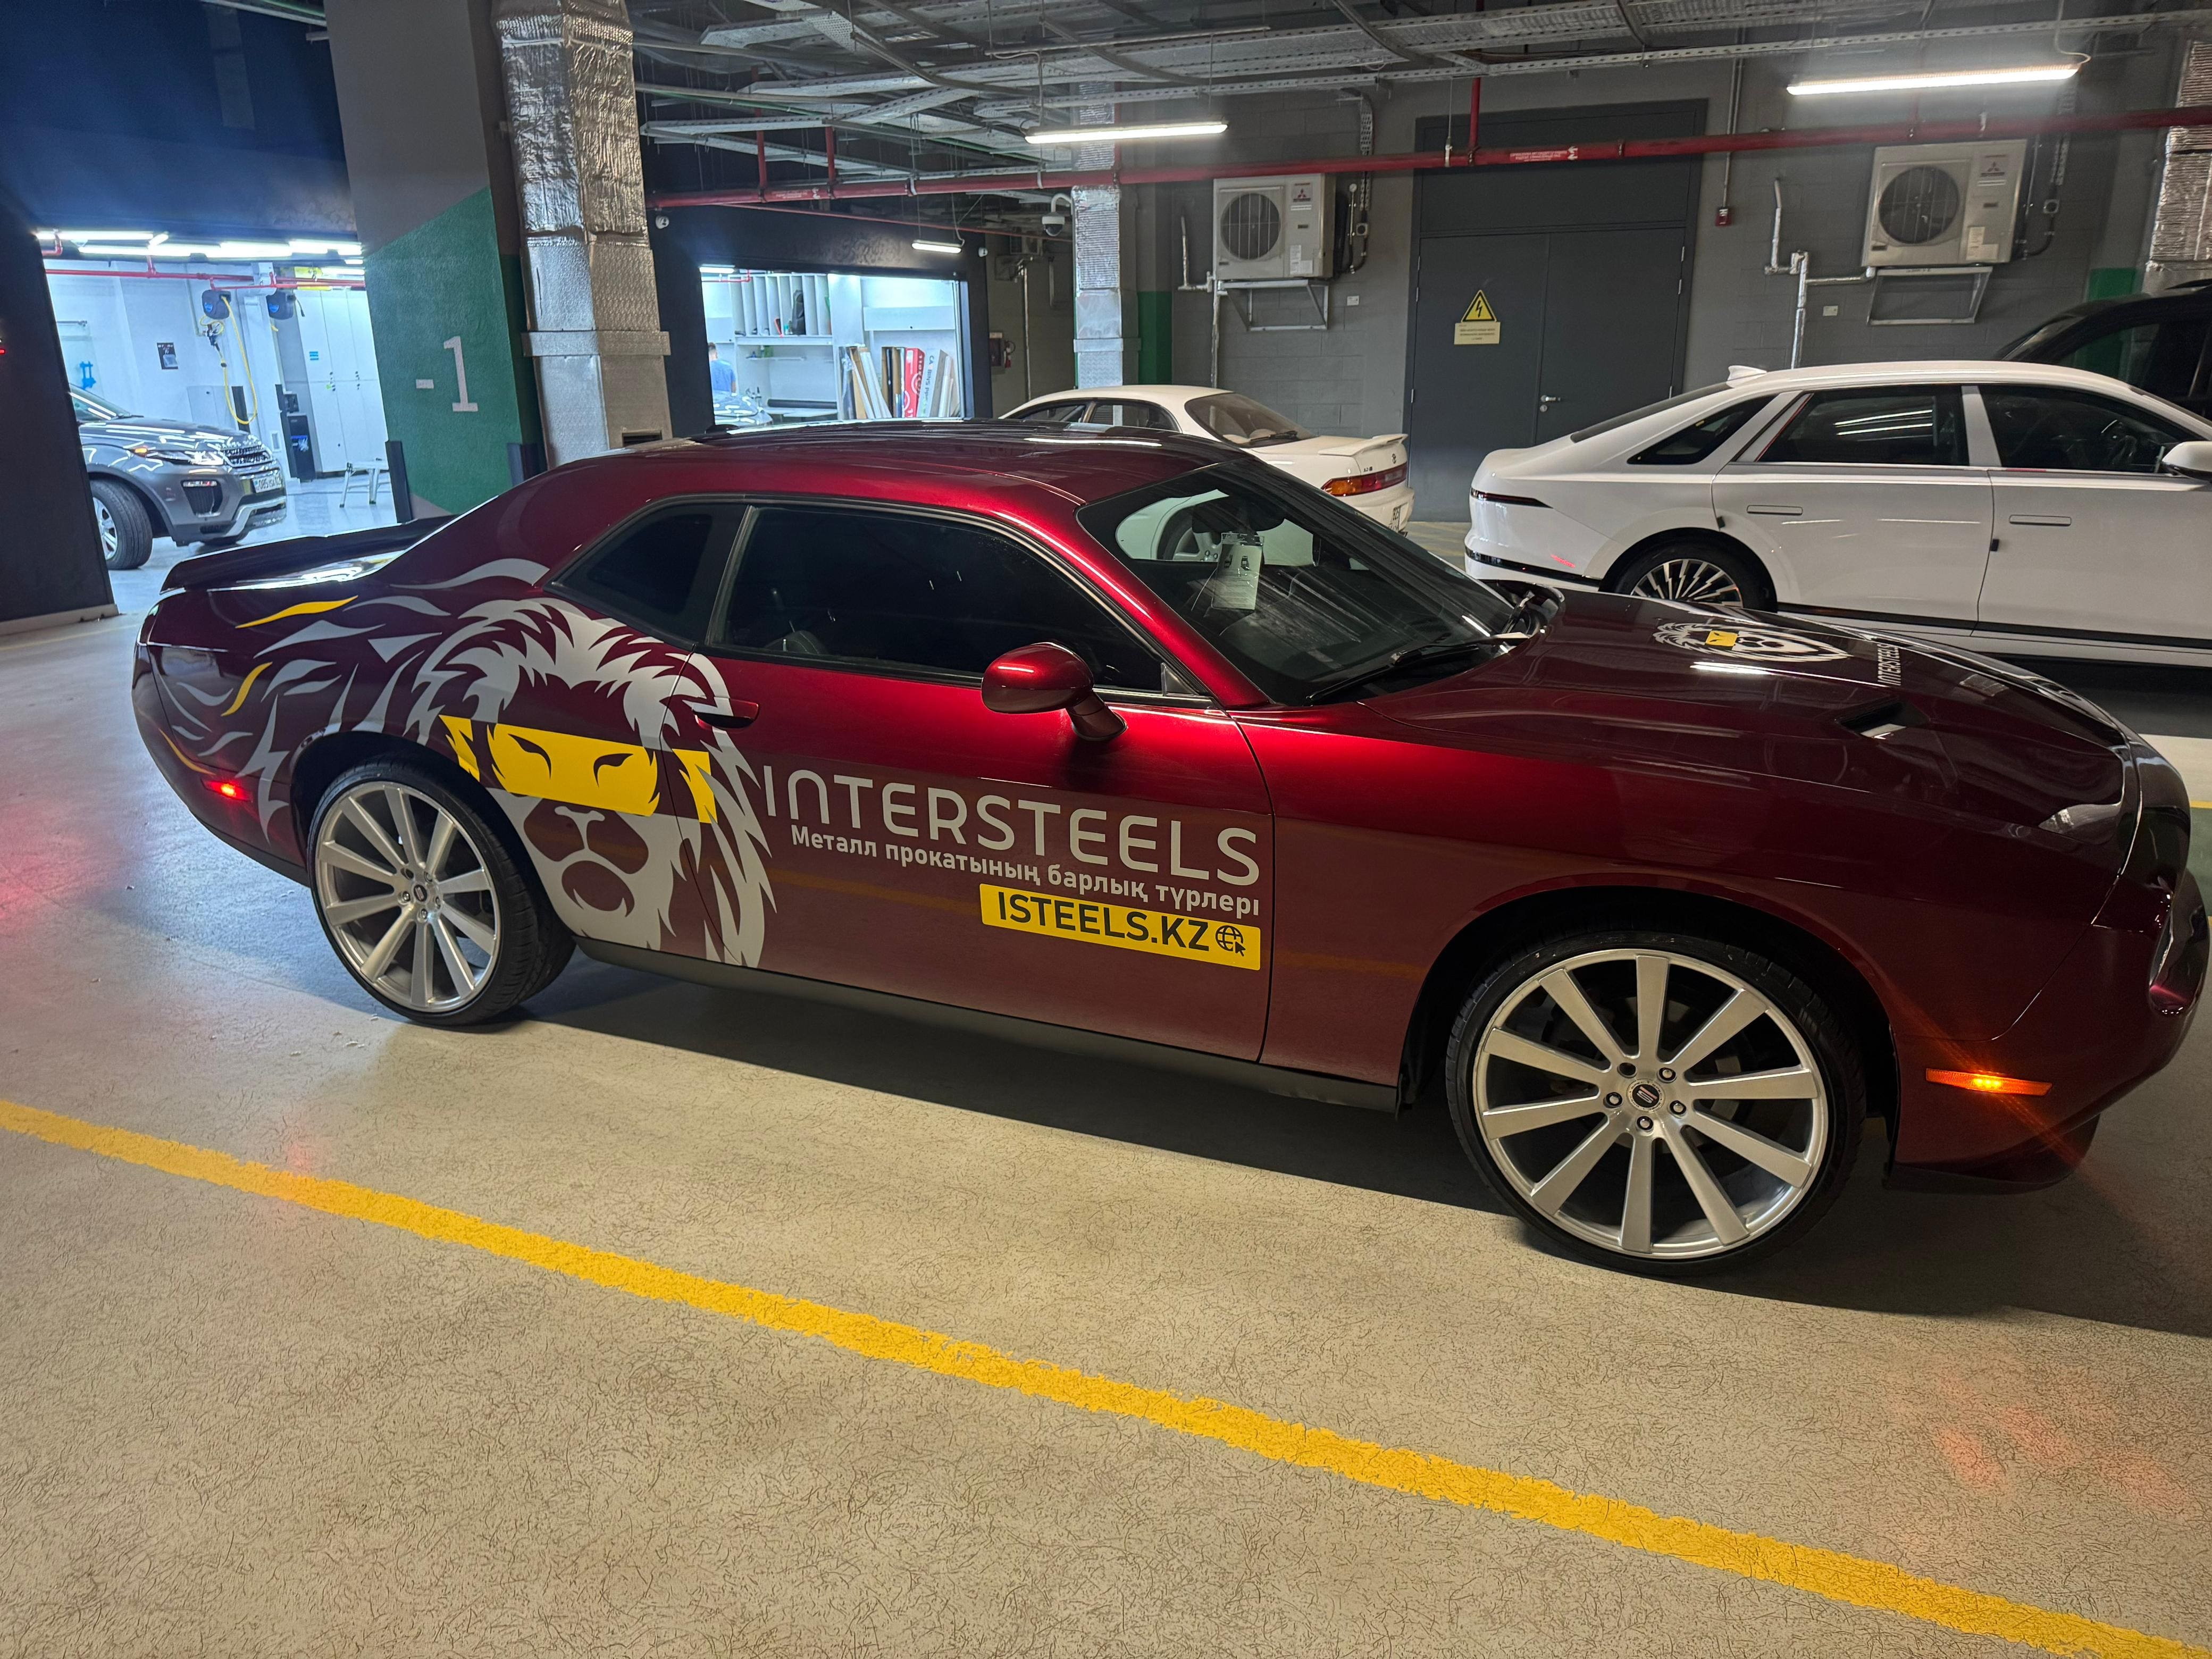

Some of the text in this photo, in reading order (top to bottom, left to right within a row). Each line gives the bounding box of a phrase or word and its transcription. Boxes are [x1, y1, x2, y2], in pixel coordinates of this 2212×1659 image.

[764, 765, 1259, 886] INTERSTEELS
[791, 824, 877, 857] Металл
[885, 844, 1041, 886] прокатының
[1048, 864, 1149, 903] барлық
[998, 891, 1210, 952] ISTEELS.KZ
